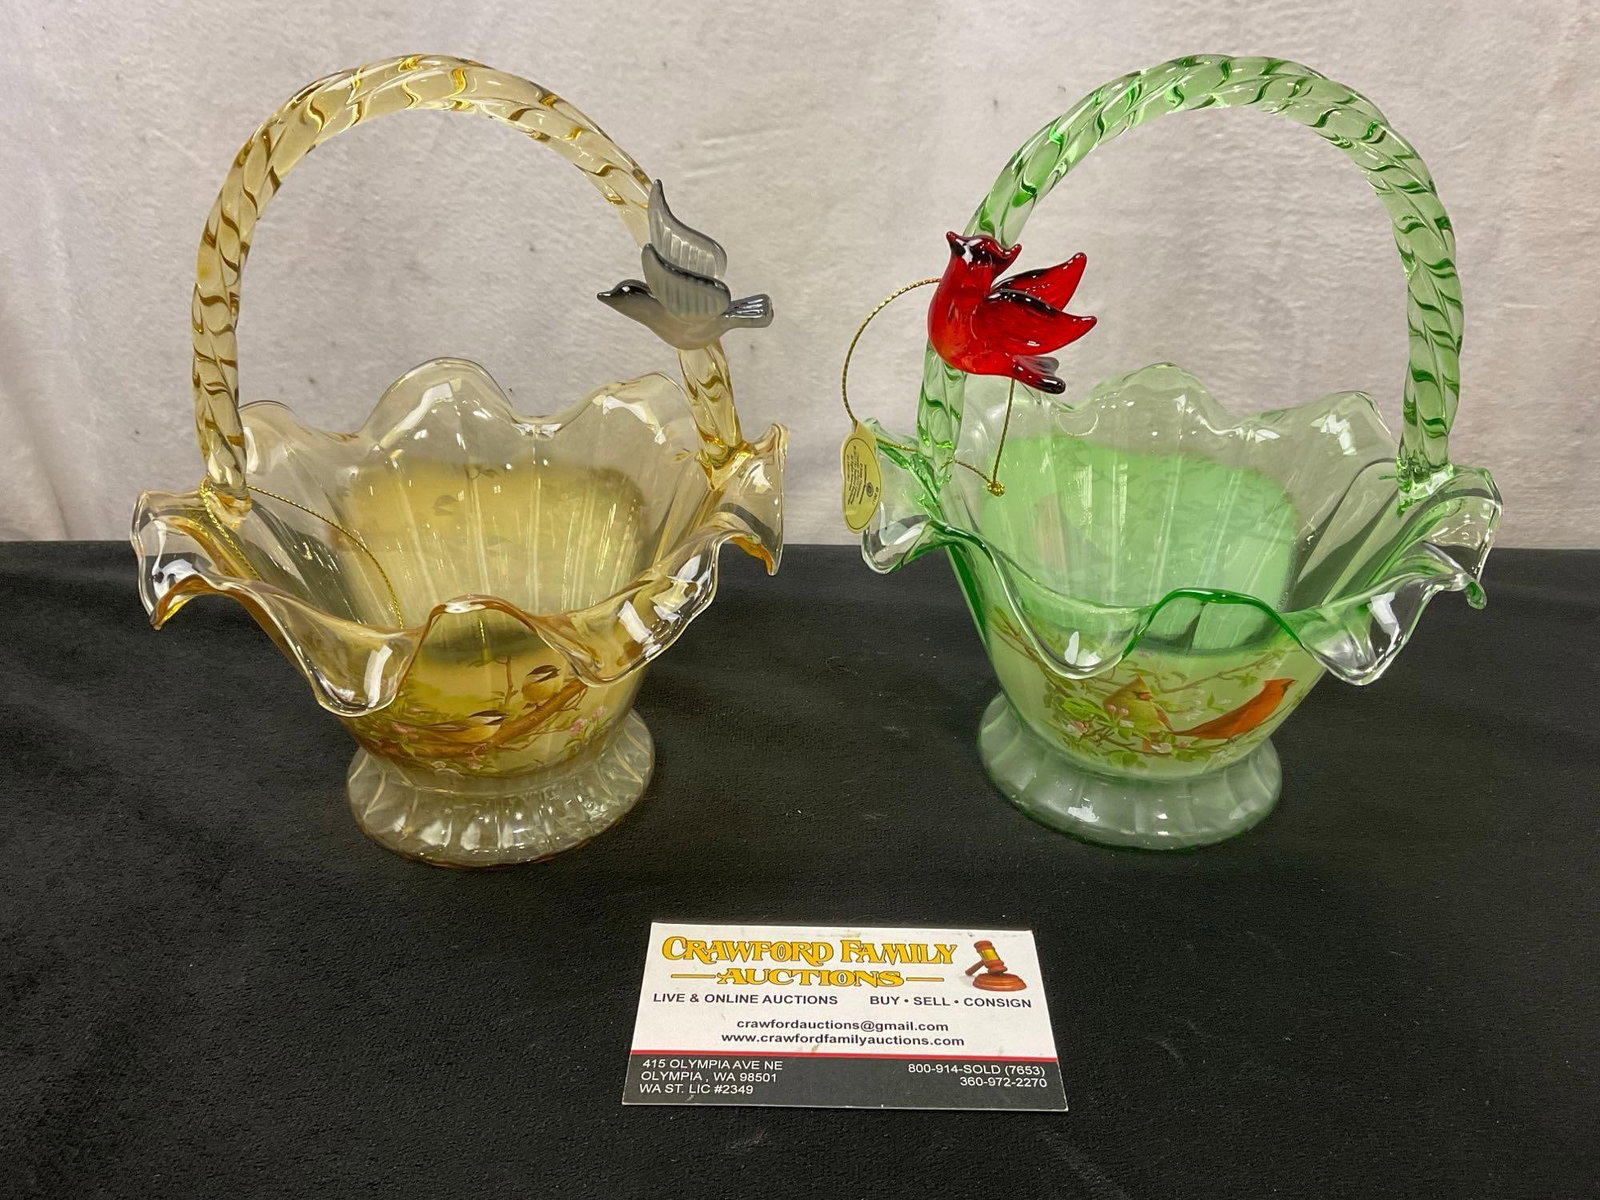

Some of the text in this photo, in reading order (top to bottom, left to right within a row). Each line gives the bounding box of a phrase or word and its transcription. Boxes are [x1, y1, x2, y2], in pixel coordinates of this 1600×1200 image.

[662, 936, 958, 967] CRAWFORD FAMILY
[717, 968, 905, 988] AUCTIONS
[653, 993, 838, 1005] LIVE & ONLINE AUCTIONS
[870, 996, 1032, 1008] BUY SELL CONSIGN
[736, 1019, 949, 1033] crawfordauctions@gmail.com
[721, 1033, 965, 1046] www.crawfordfamilyauctions.com
[642, 1059, 783, 1071] 415 OLYMPIA AVE NE
[908, 1063, 1046, 1077] 800-914-SOLD (7653)
[713, 1072, 736, 1082] WA
[739, 1072, 777, 1082] 98501
[960, 1076, 1048, 1088] 360-972-2270
[639, 1083, 754, 1095] WA ST. LIC #2349
